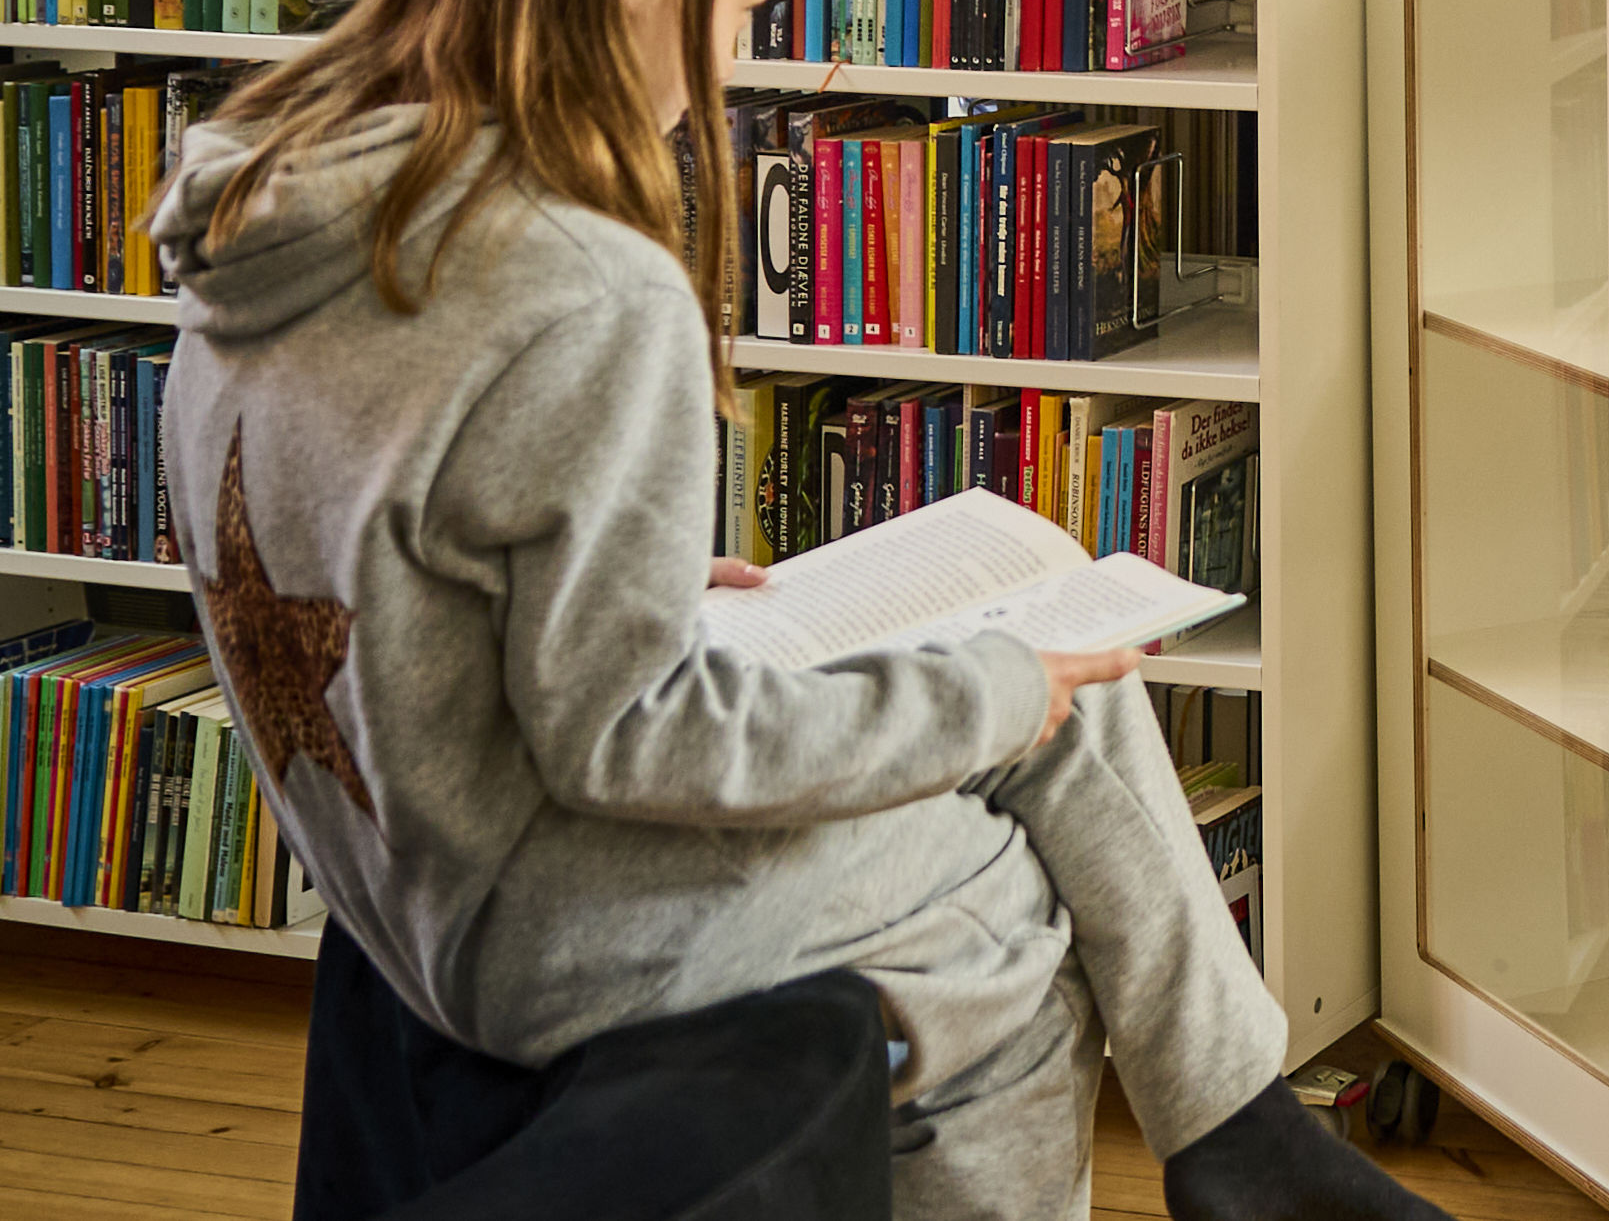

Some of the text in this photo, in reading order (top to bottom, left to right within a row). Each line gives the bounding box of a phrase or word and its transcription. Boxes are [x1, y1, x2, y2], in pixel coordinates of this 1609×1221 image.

[796, 164, 809, 307] DEN FALDNE DJÆVEL
[780, 402, 788, 450] MARIANNE
[1191, 402, 1243, 436] Der findes
[1182, 440, 1193, 460] da
[1195, 430, 1217, 454] ikke
[780, 451, 788, 486] CURLEY
[157, 489, 167, 531] VOGTER
[780, 493, 788, 505] DE
[1070, 473, 1080, 526] ROBINSON
